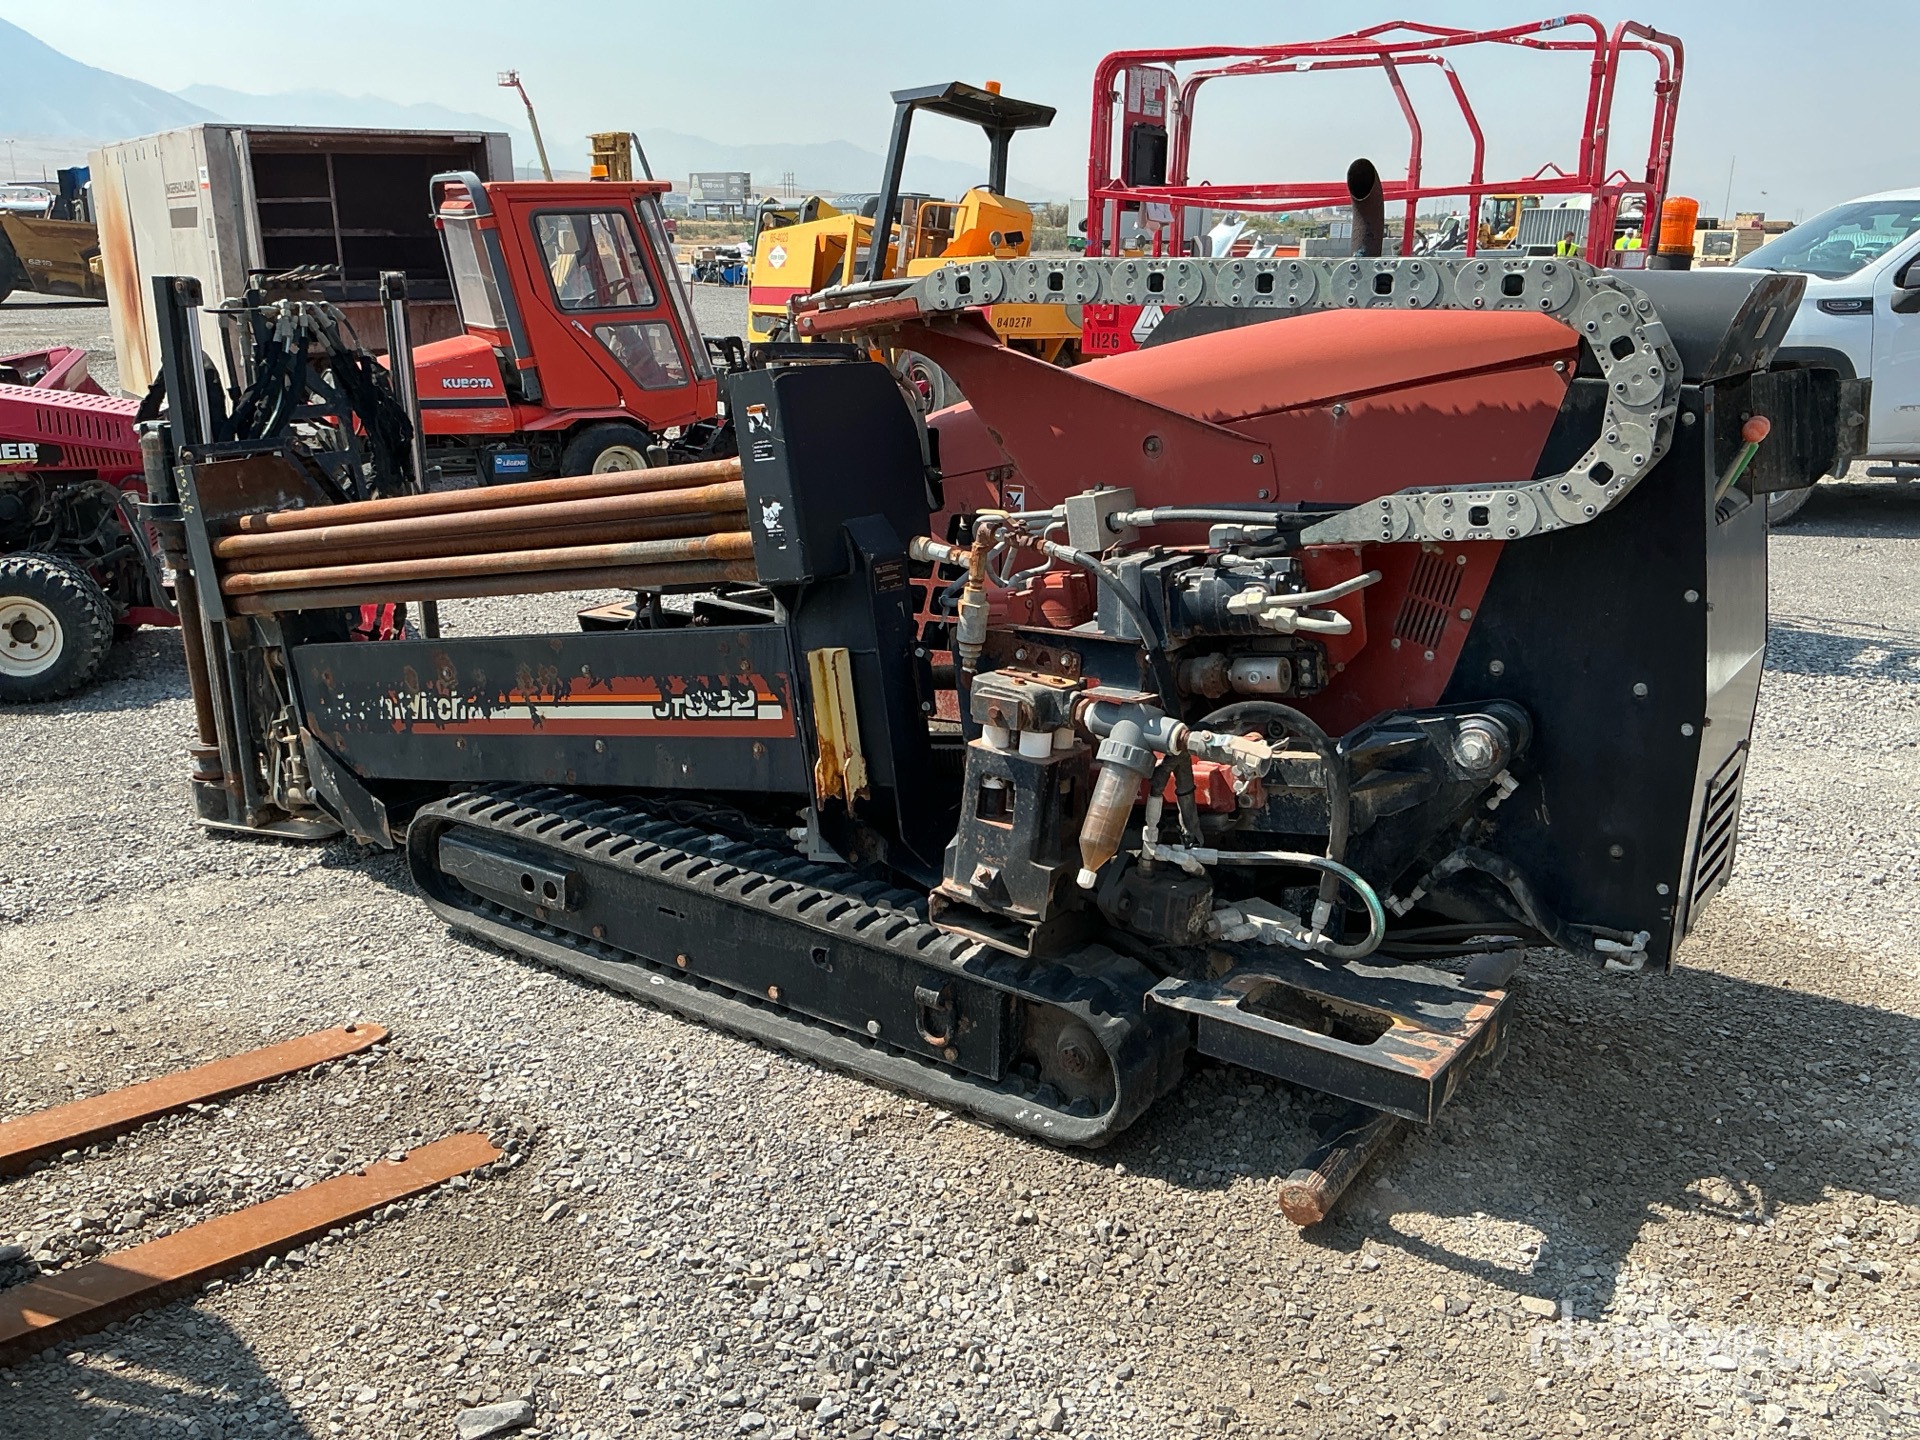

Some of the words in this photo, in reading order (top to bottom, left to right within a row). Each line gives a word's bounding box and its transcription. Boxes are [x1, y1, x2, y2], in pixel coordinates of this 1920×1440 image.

[996, 317, 1032, 329] 84027R
[442, 378, 494, 389] KUBOTA
[0, 443, 38, 459] ER
